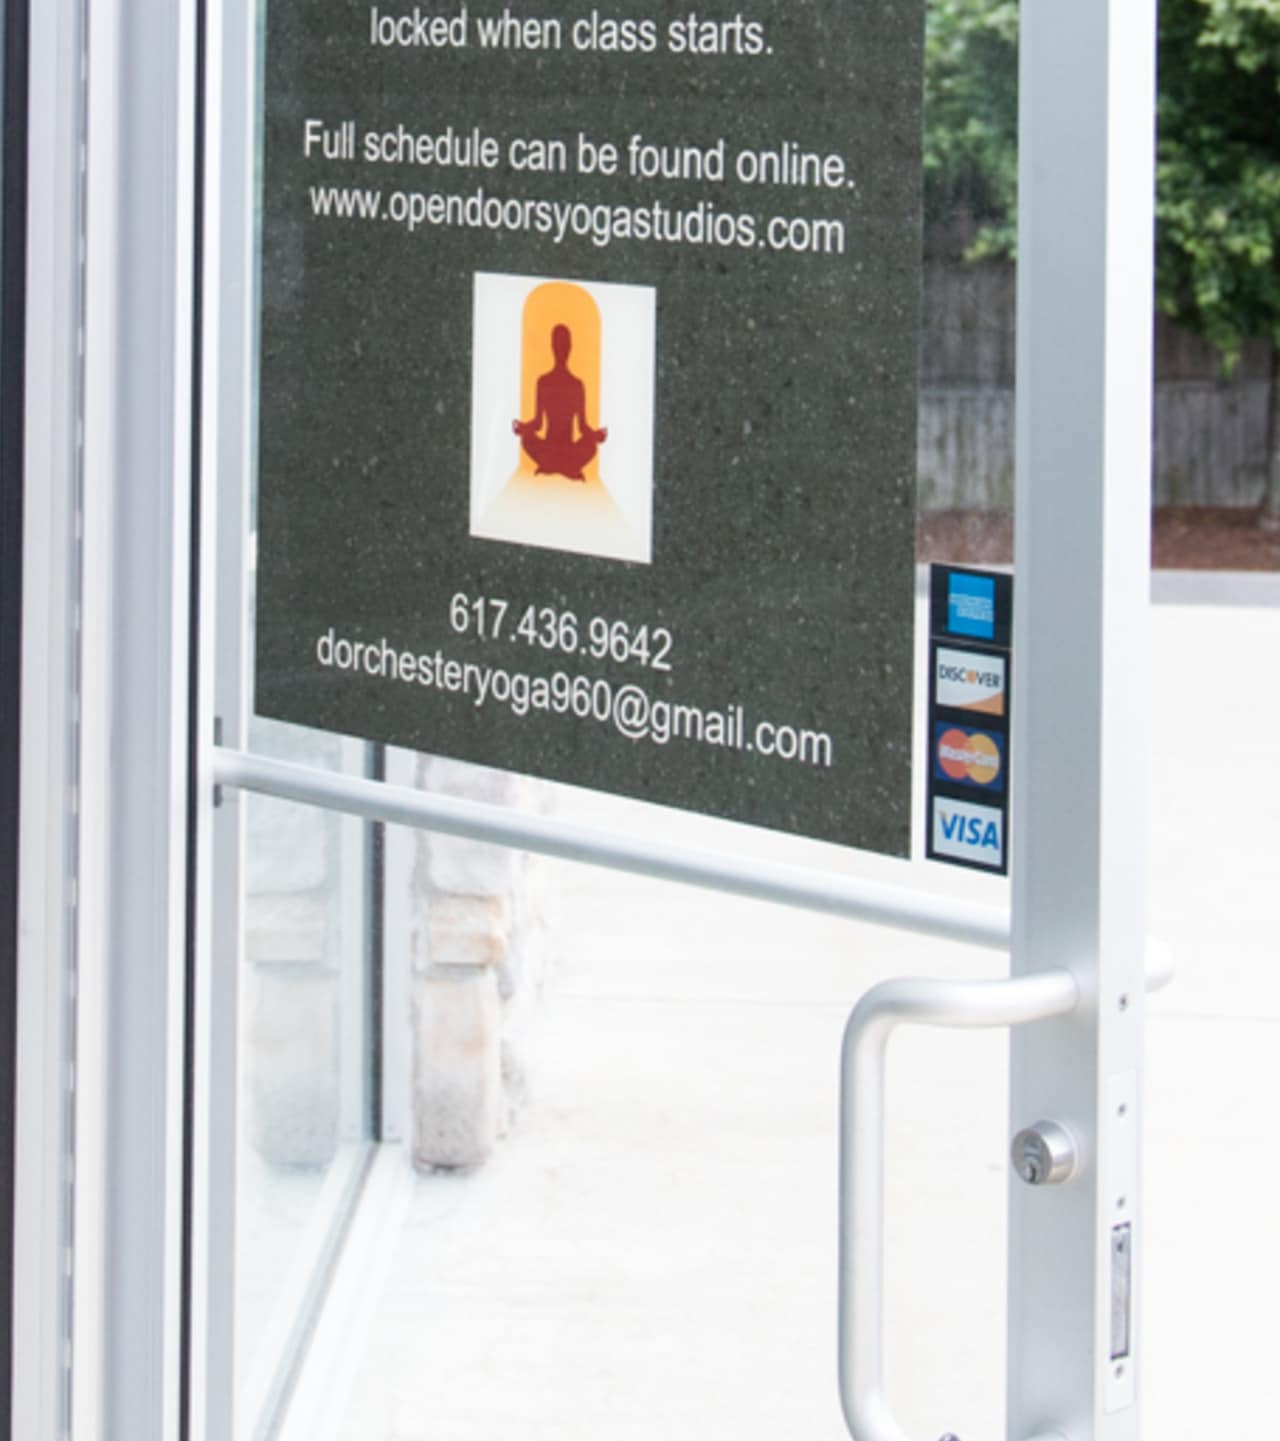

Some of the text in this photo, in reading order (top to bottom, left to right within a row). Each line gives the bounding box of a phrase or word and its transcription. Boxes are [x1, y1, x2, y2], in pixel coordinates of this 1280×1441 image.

[370, 7, 773, 55] locked when class starts.
[304, 119, 855, 189] Full schedule can be found online.
[309, 183, 846, 254] www.opendoorsyogastudios.com
[449, 592, 673, 671] 617.436.9642
[316, 628, 832, 766] dorchesteryoga960@gmail.com
[939, 665, 1000, 688] DISCOVER
[939, 811, 999, 849] VISA
